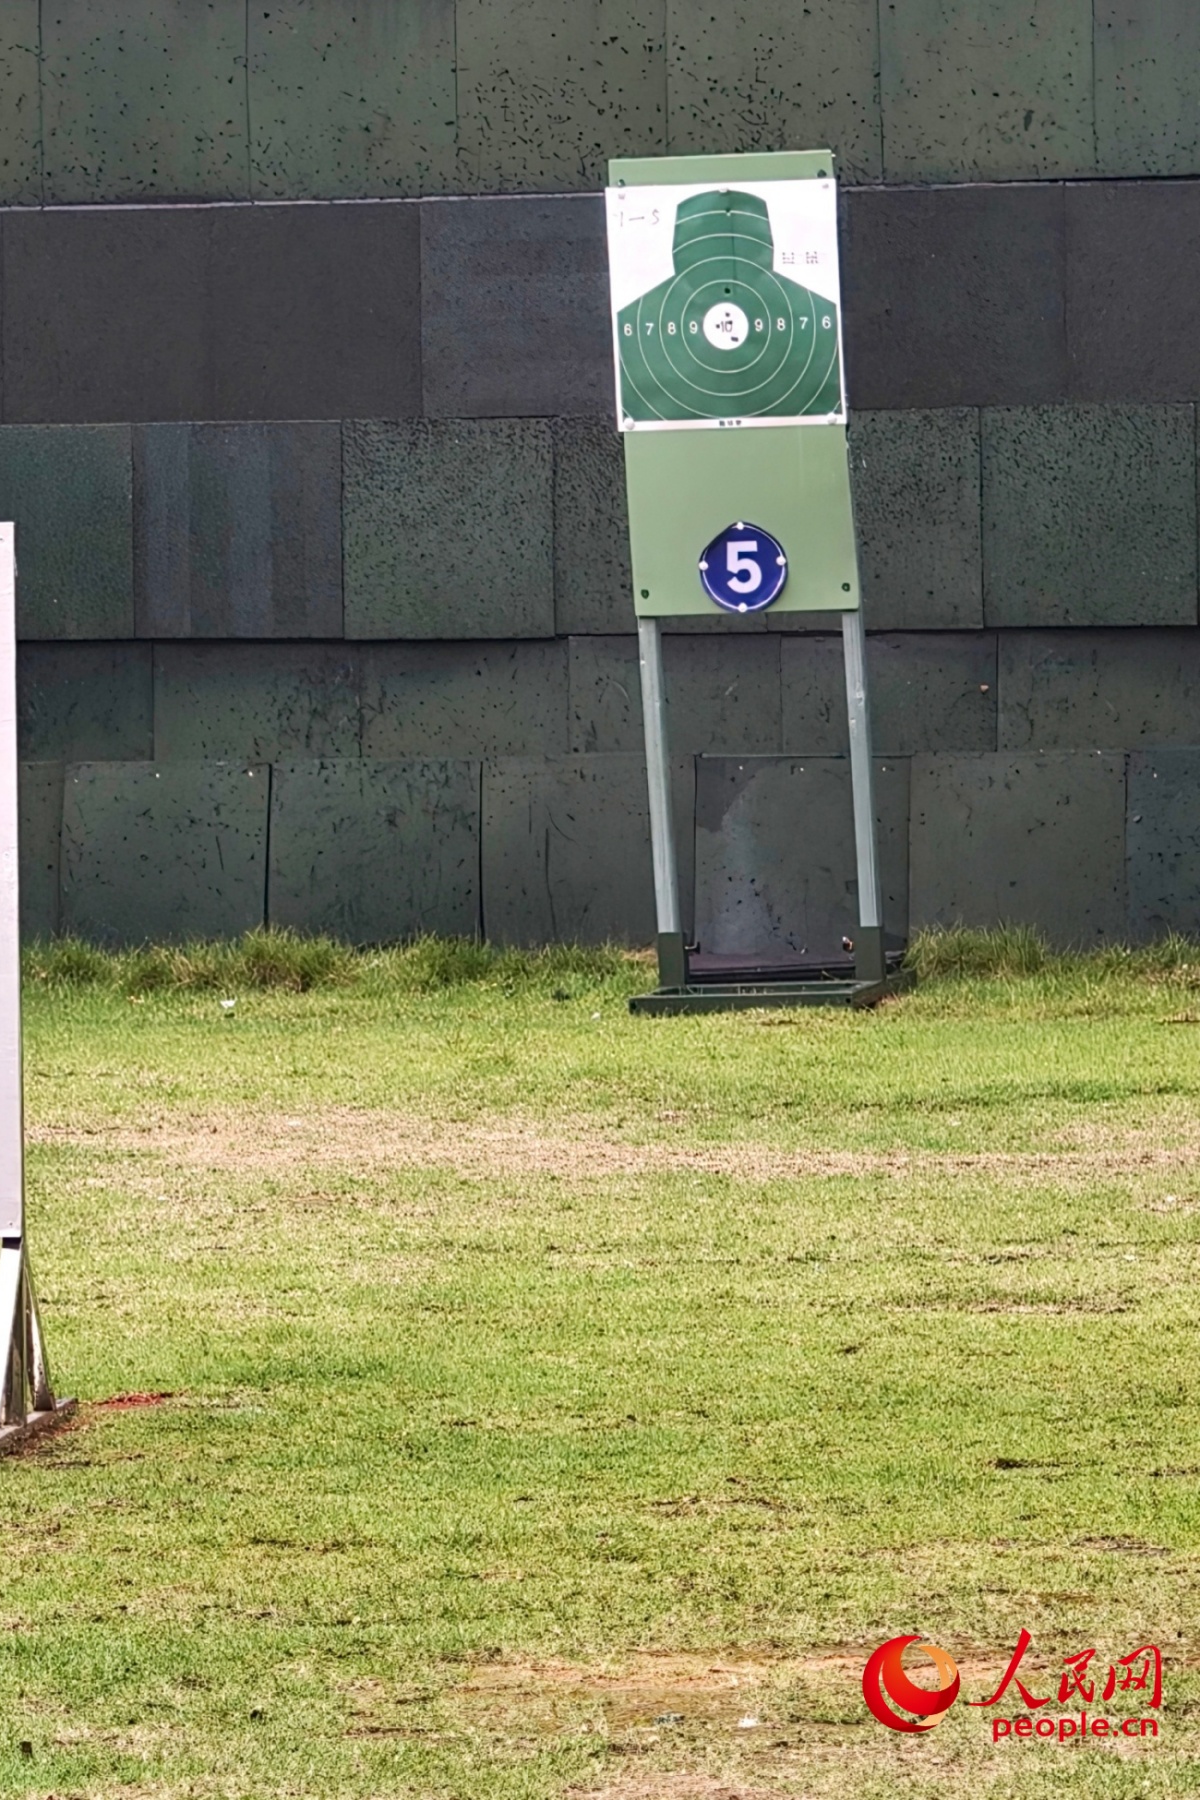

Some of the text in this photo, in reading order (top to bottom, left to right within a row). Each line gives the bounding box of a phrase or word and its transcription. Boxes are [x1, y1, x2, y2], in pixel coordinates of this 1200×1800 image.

[624, 316, 831, 336] 6 7 8 9 10 9 8 7 6
[726, 540, 762, 594] 5
